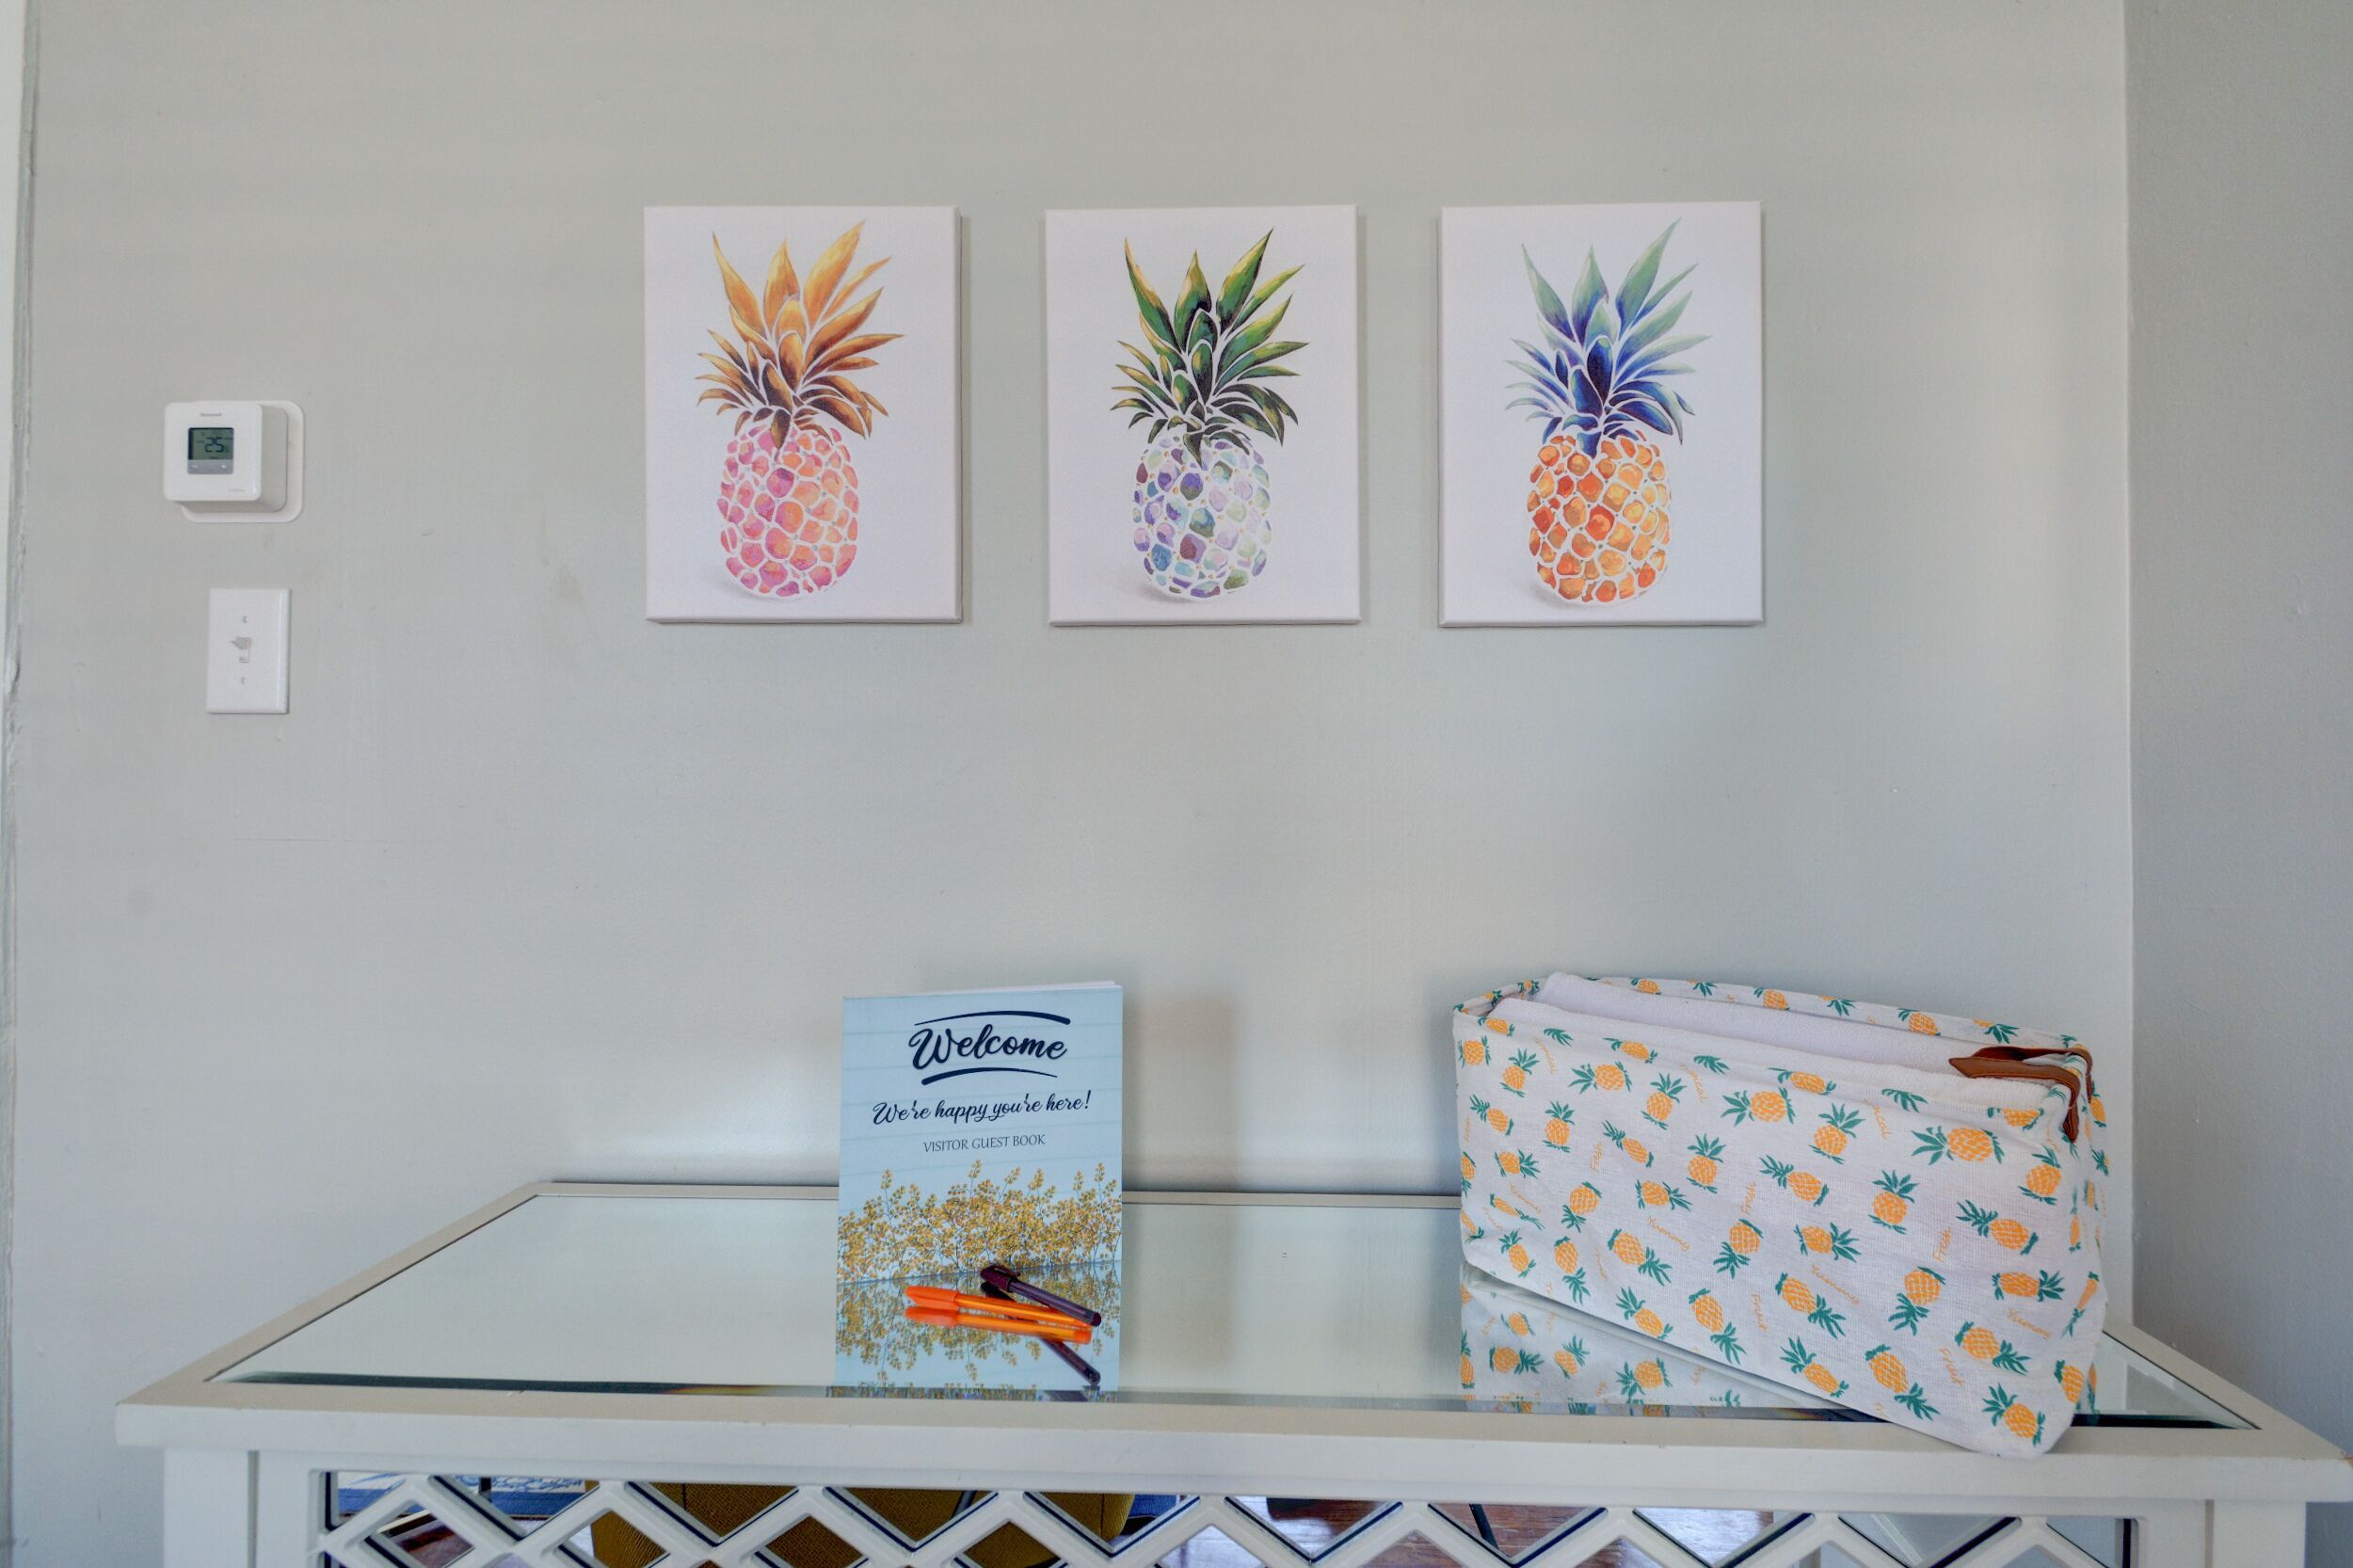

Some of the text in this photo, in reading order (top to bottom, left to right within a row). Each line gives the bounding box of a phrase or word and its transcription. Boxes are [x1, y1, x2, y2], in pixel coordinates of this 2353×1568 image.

[204, 437, 224, 453] 25
[908, 1024, 1067, 1069] Welcome
[872, 1090, 1092, 1125] We're happy you're here!
[923, 1134, 1046, 1152] VISITOR GUEST BOOK
